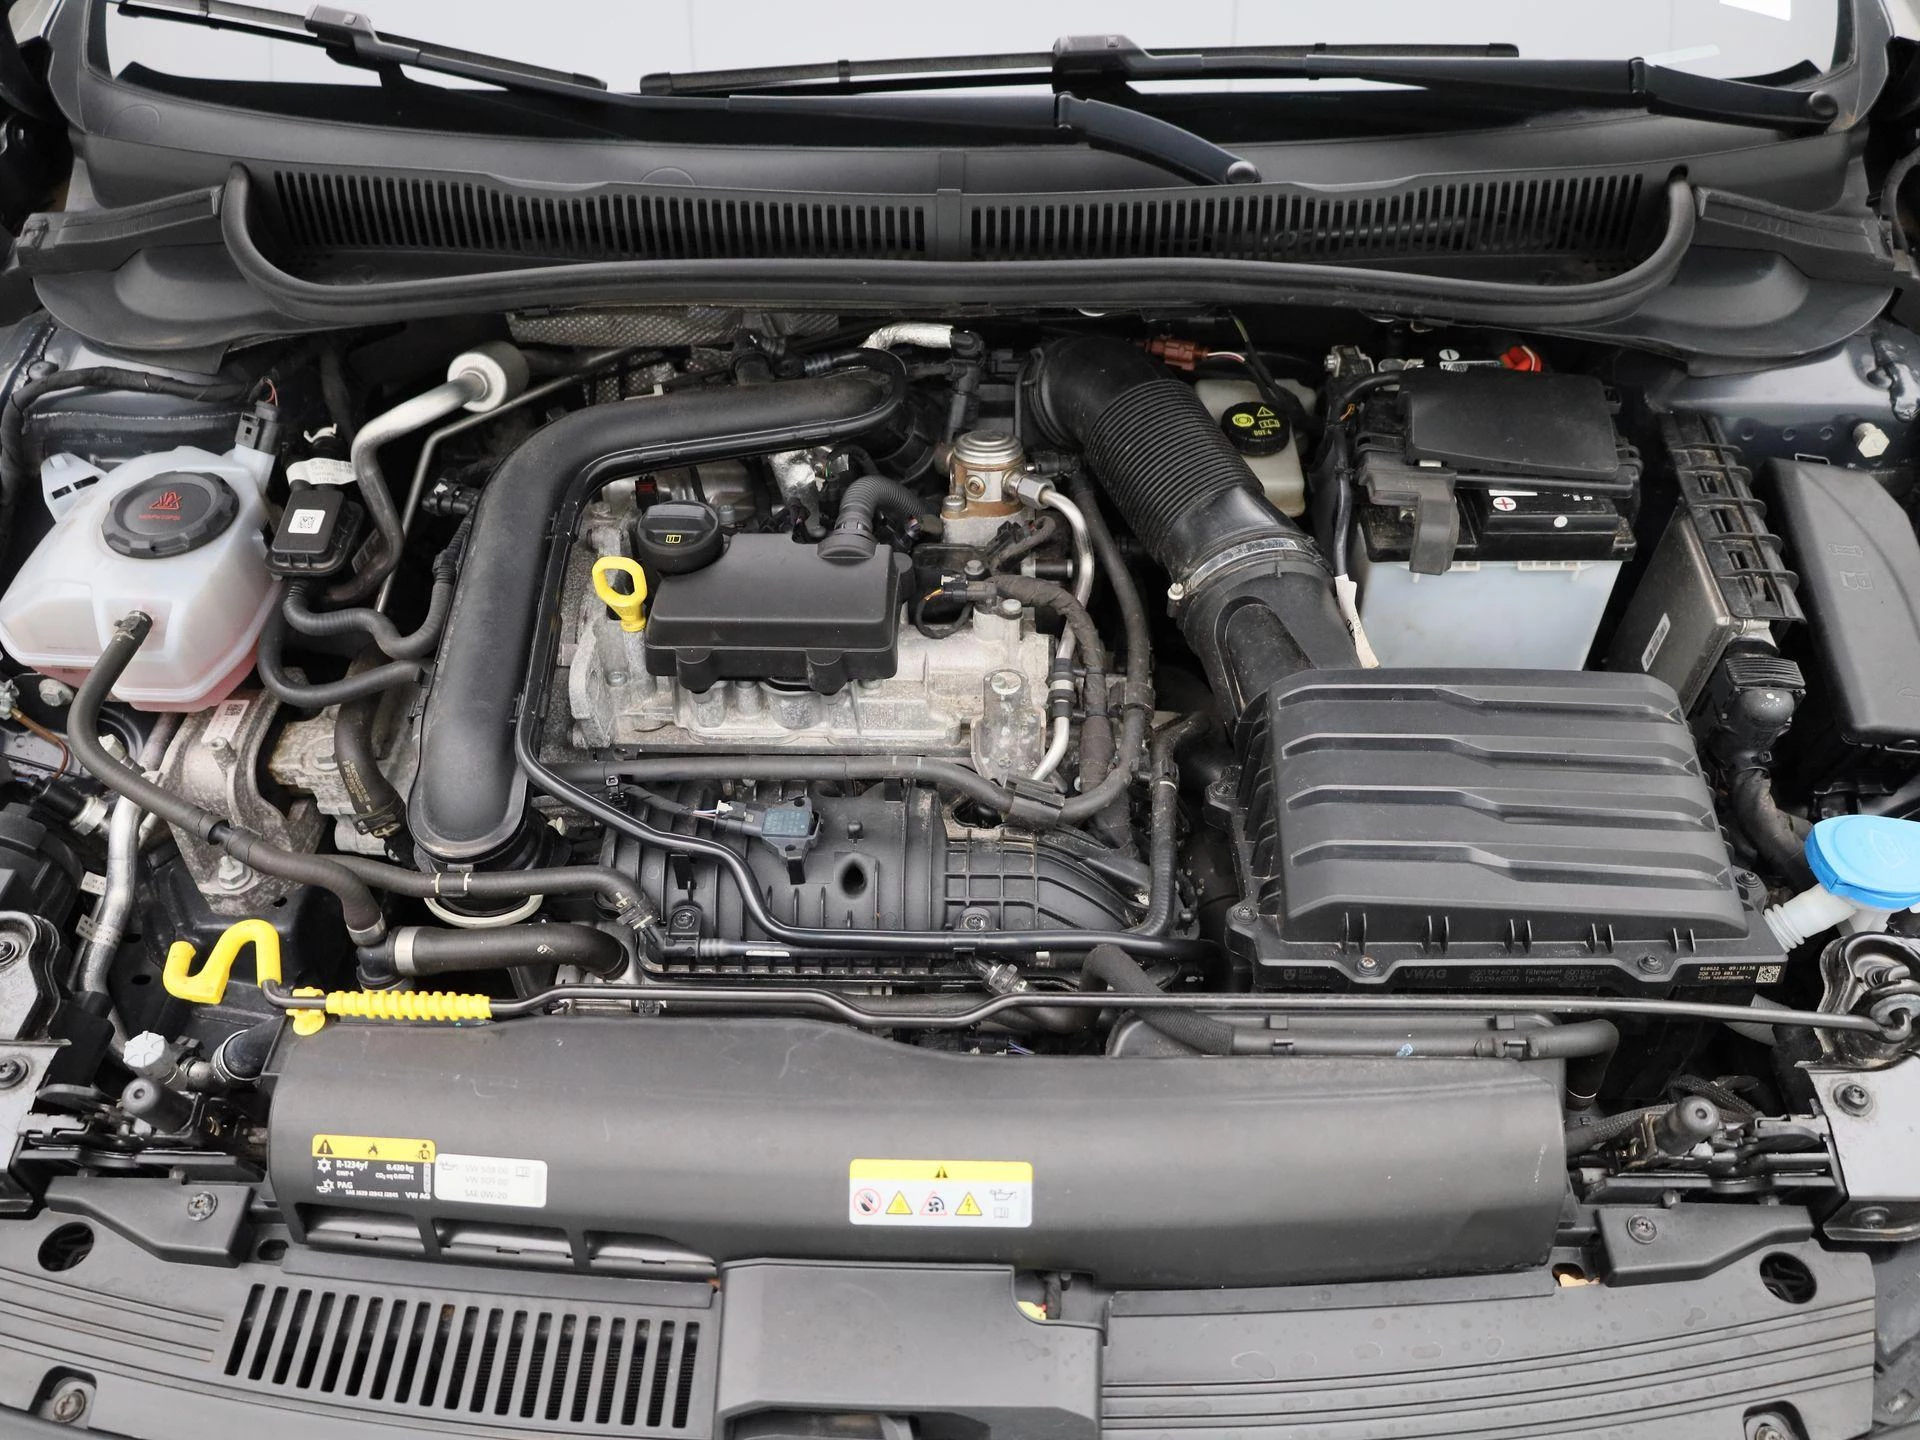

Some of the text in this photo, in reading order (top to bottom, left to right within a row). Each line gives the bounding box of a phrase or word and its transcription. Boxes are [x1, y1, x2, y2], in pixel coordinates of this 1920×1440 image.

[336, 1160, 369, 1171] R-1234yf
[336, 1181, 353, 1189] PAG
[405, 1191, 431, 1200] VW AG
